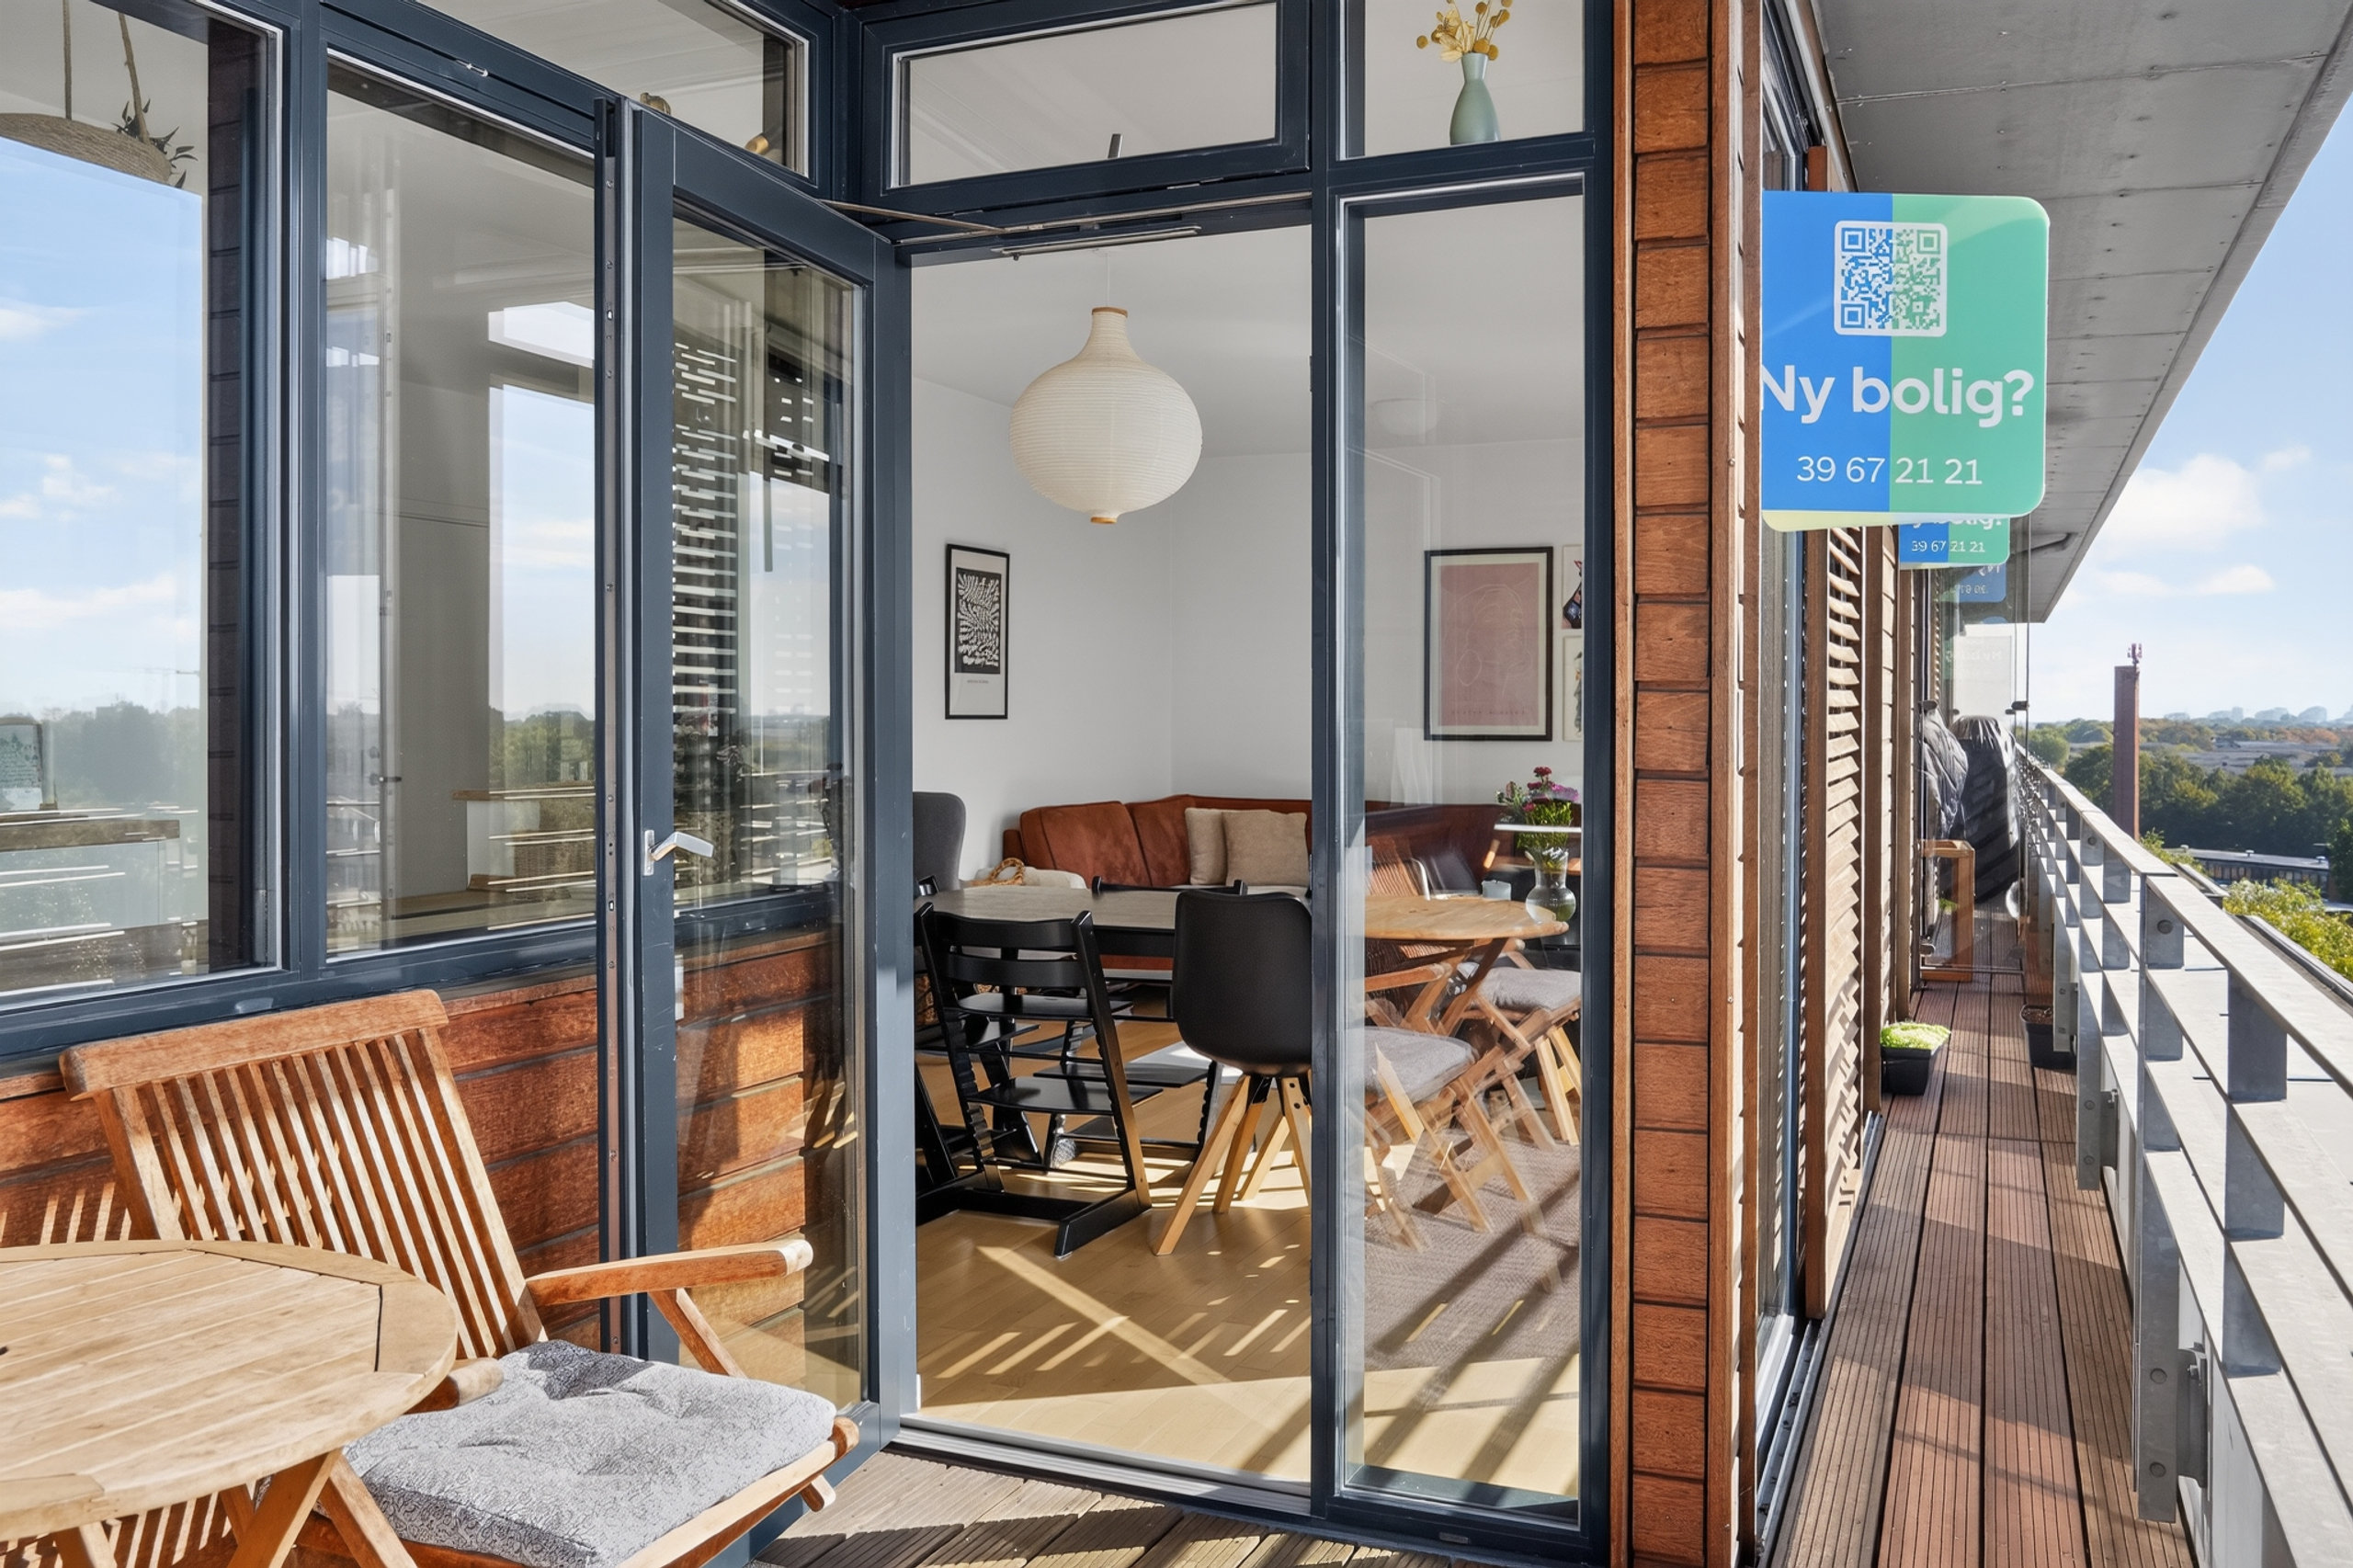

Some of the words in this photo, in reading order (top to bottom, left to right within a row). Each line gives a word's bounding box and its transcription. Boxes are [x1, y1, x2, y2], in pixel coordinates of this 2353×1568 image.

[1761, 365, 1836, 424] Ny
[1853, 366, 2035, 427] bolig?
[1797, 456, 1836, 483] 39
[1846, 457, 1886, 483] 67
[1895, 458, 1934, 483] 21
[1944, 459, 1983, 484] 21
[1911, 540, 1927, 551] 39
[1931, 540, 1947, 552] 67
[1950, 541, 1965, 552] 21
[1970, 541, 1985, 552] 21
